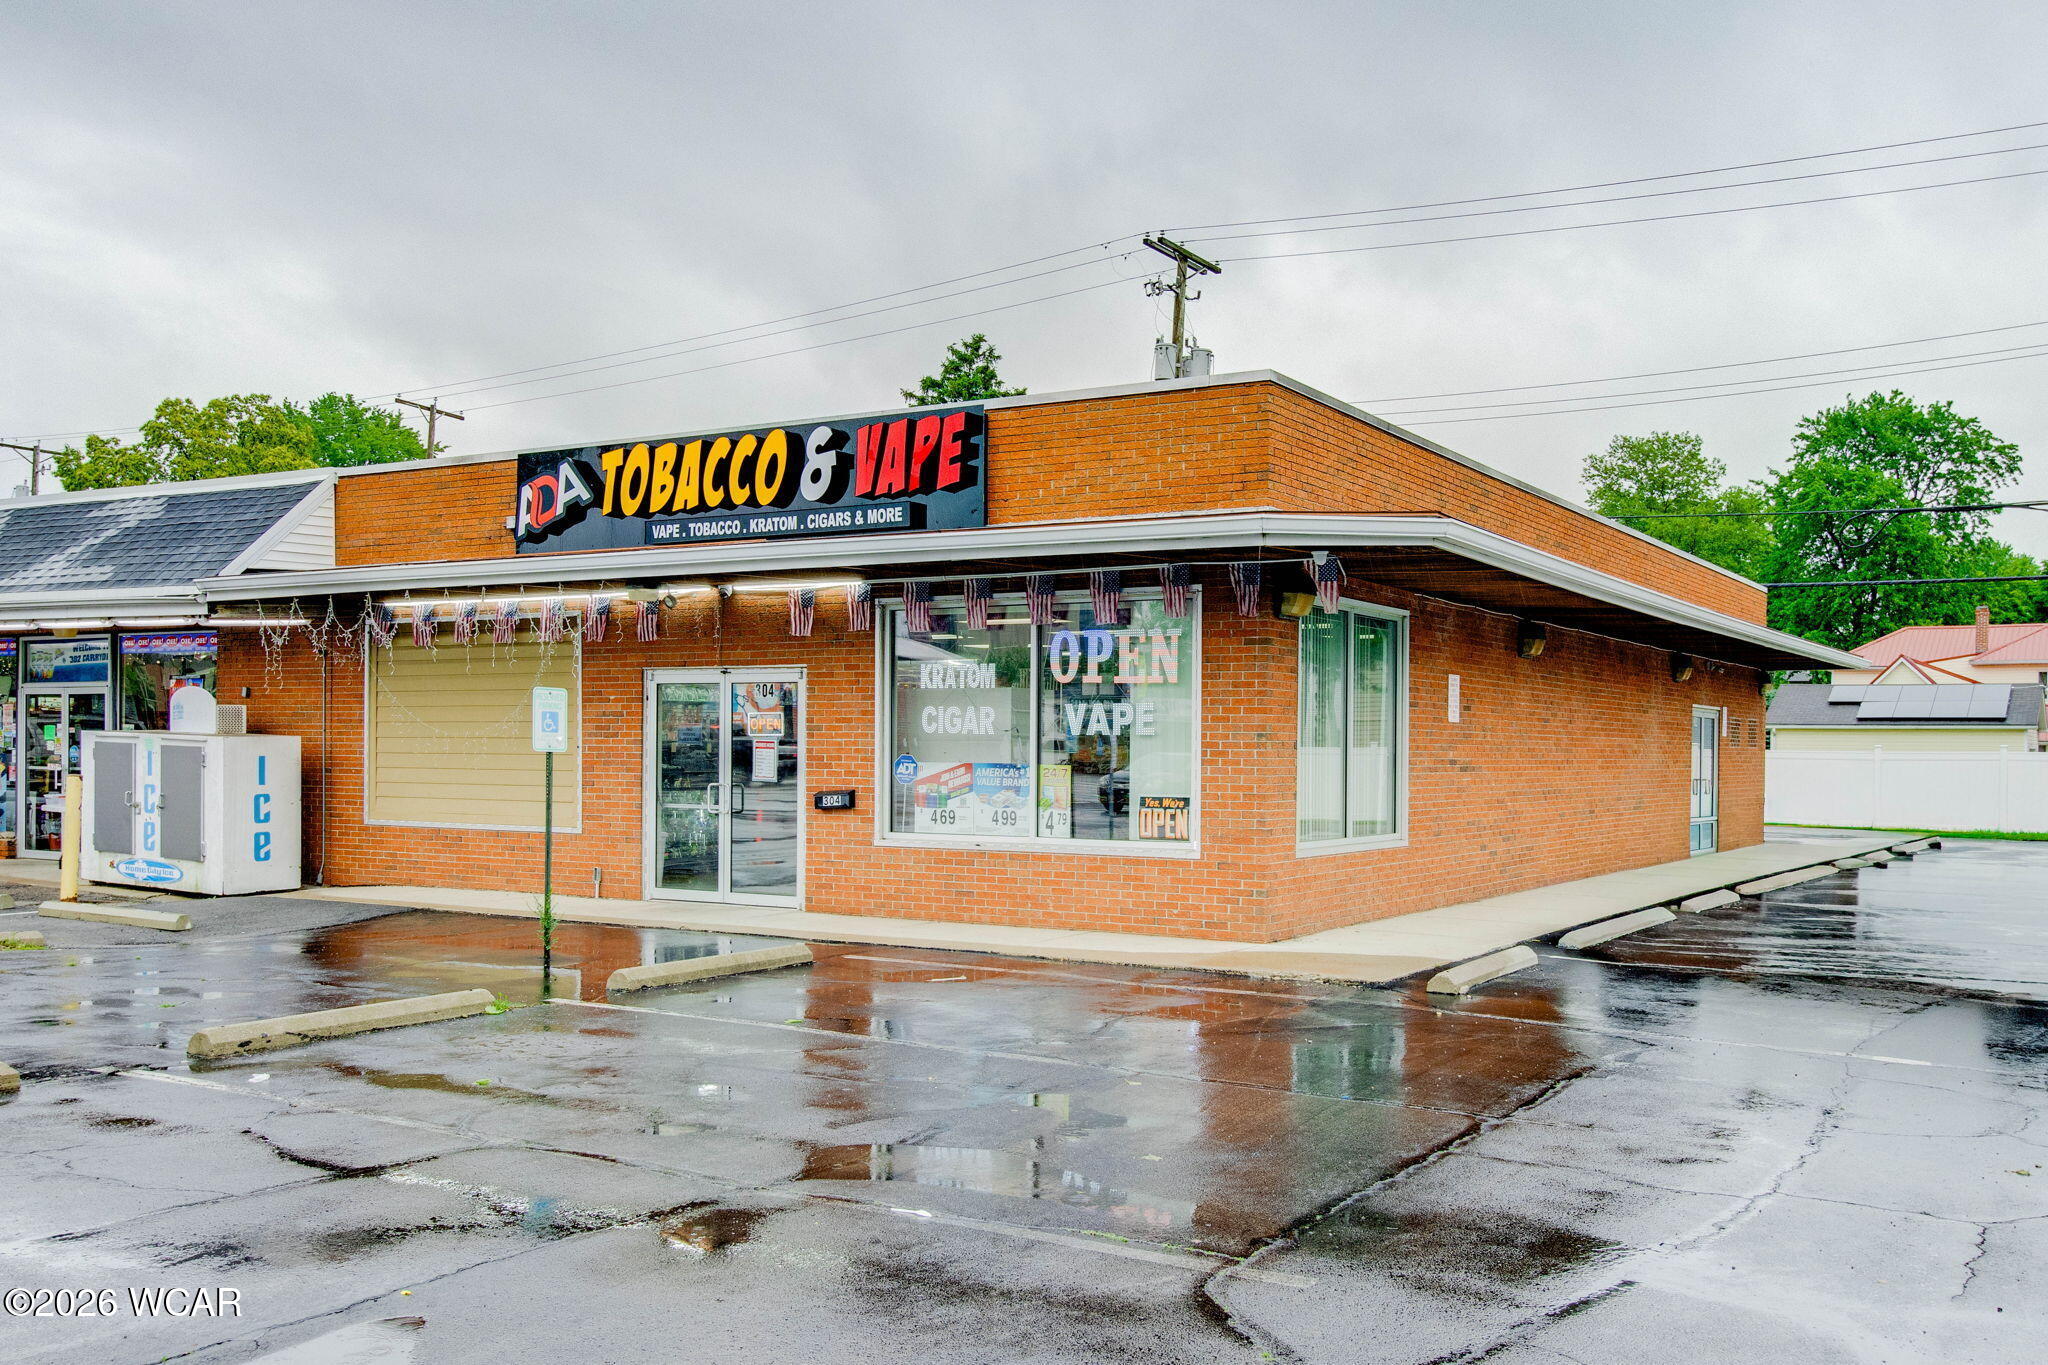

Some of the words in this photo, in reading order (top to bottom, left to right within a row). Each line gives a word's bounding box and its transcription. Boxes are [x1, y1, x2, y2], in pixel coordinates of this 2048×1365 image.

[516, 460, 591, 538] ADA
[602, 428, 788, 517] TOBACCO
[800, 426, 837, 501] &
[855, 411, 966, 497] VAPE
[652, 525, 680, 539] VAPE
[688, 520, 741, 536] TOBACCO
[750, 516, 798, 533] KRATOM
[807, 511, 851, 529] CIGARS
[855, 510, 864, 525] &
[867, 507, 903, 524] MORE
[1050, 628, 1182, 684] OPEN
[920, 663, 996, 689] KRATOM
[756, 684, 774, 697] 304
[749, 718, 781, 731] OPEN
[921, 706, 997, 735] CIGAR
[1065, 702, 1155, 736] VAPE
[896, 763, 917, 775] ADT
[976, 777, 1001, 787] VALUE
[1002, 777, 1030, 787] BRAND
[823, 796, 840, 806] 304
[930, 809, 956, 825] 469
[991, 810, 1018, 826] 499
[1139, 809, 1189, 840] OPEN
